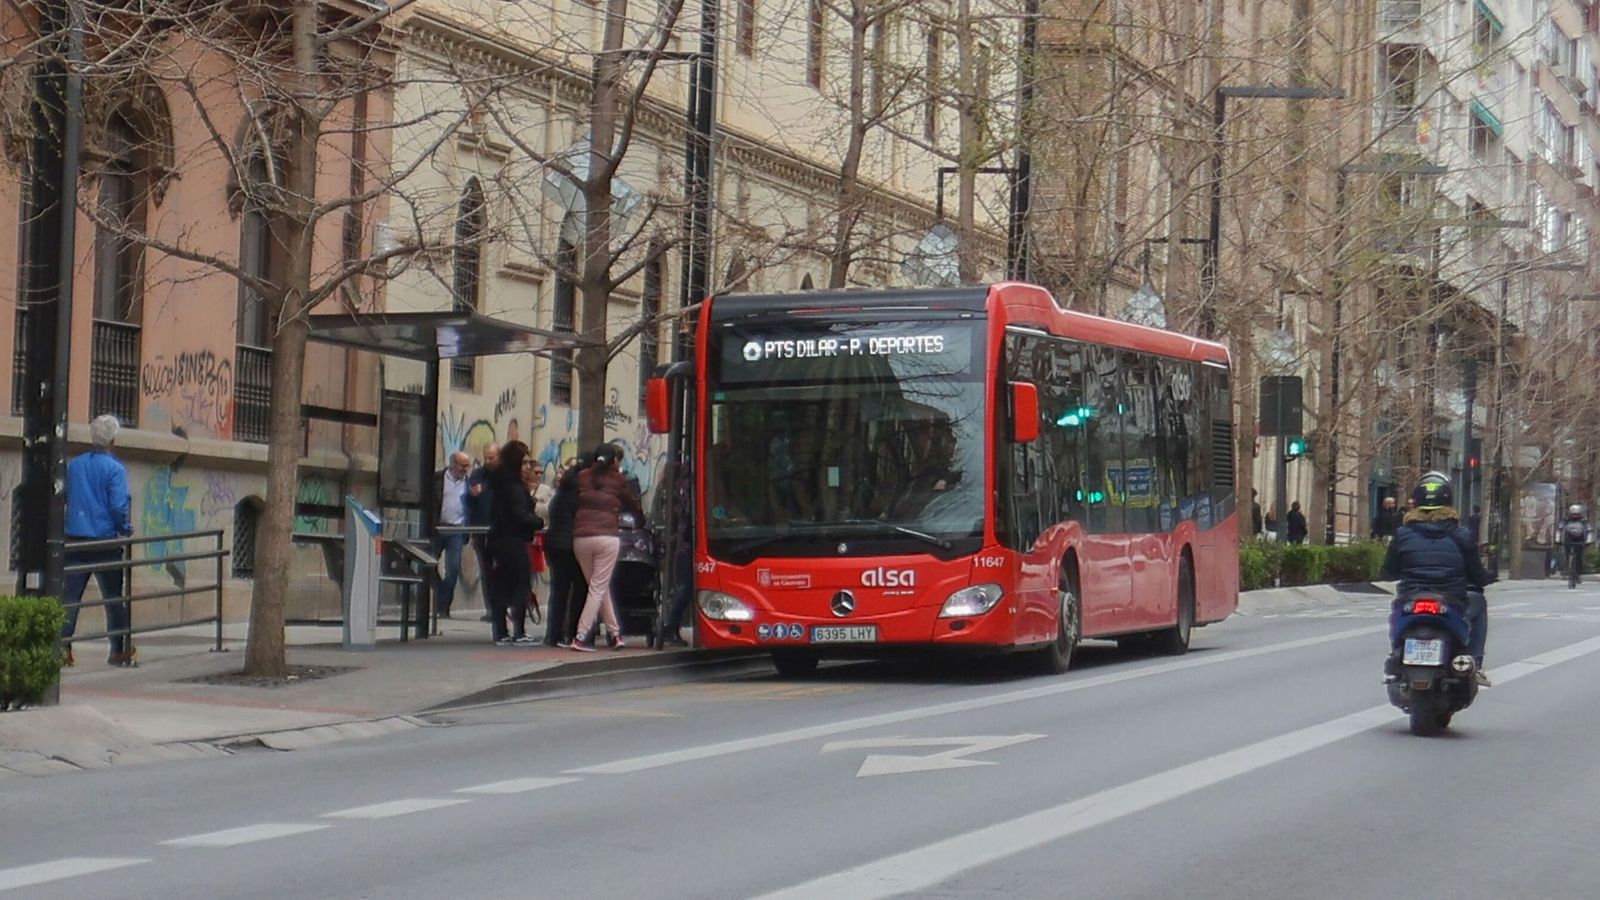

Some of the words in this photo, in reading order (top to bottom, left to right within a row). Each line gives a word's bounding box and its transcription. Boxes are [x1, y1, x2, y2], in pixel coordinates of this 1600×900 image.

[765, 341, 794, 359] PTS
[797, 340, 837, 358] DILAR
[850, 338, 864, 356] P.
[870, 335, 945, 355] DEPORTES
[695, 562, 715, 573] 647
[973, 556, 1004, 568] 11647
[861, 566, 915, 587] alsa
[816, 629, 847, 640] 6395
[850, 628, 872, 640] LHY
